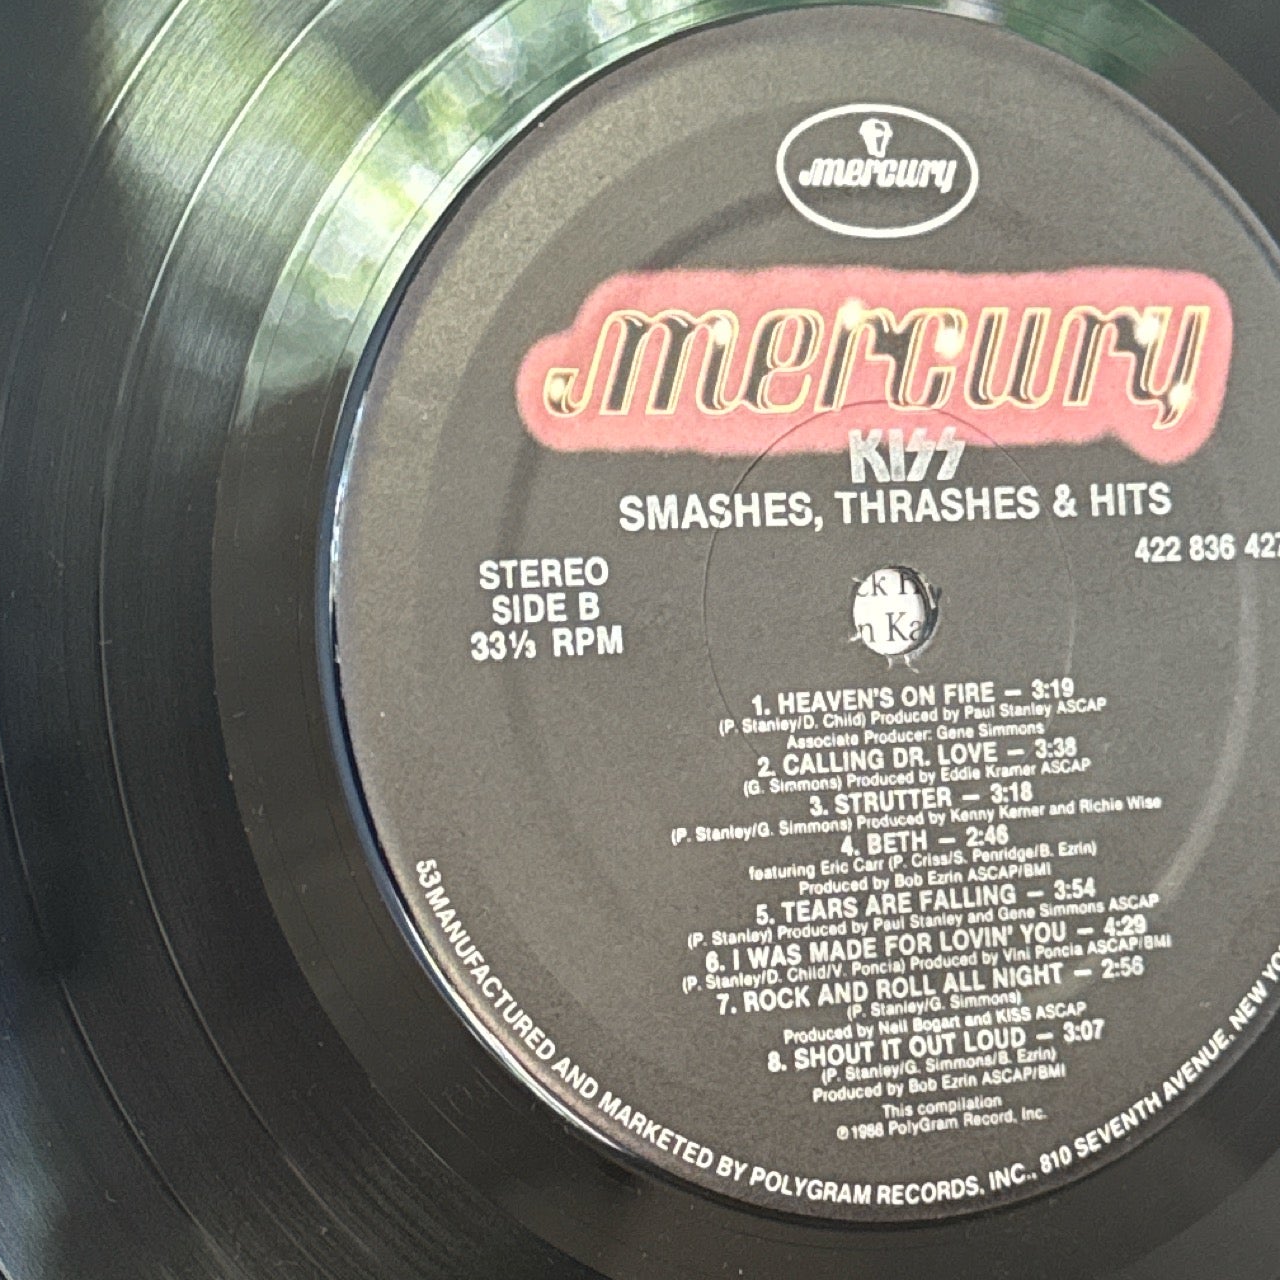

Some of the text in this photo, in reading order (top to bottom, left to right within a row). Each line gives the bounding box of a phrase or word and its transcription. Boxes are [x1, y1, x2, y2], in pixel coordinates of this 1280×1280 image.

[798, 158, 957, 194] mercury
[543, 304, 1210, 431] mercury
[848, 428, 966, 484] KISS
[619, 481, 1172, 532] SMASHES, THRASHES & HITS
[1135, 536, 1182, 563] 422
[1189, 533, 1236, 561] 836
[480, 556, 608, 589] STEREO
[492, 592, 600, 625] SIDE B
[552, 625, 624, 657] RPM
[752, 677, 1074, 716] 1. HEAVEN'S ON FIRE 3:19
[757, 736, 1077, 777] 2. CALLING DR. LOVE 3:38
[810, 781, 1033, 817] 3. STRUTTER 3:18
[841, 824, 1009, 856] 4. BETH 2:46
[756, 877, 1096, 926] 5. TEARS ARE FALLING 3:54
[706, 914, 1147, 975] 6. I WAS MADE FOR LOVIN' YOU 4:29
[716, 955, 1145, 1015] 7. ROCK AND ROLL ALL NIGHT 2:56
[425, 887, 556, 1061] MANUFACTURED
[552, 1057, 599, 1100] AND
[599, 1092, 714, 1170] MARKETED
[717, 1155, 745, 1182] BY
[750, 1167, 871, 1204] POLYGRAM
[876, 1176, 985, 1205] RECORDS,
[1040, 1148, 1072, 1173] 810
[1074, 1094, 1162, 1158] SEVENTH
[1164, 1029, 1235, 1101] AVENUE,
[1230, 982, 1269, 1032] NEW
[768, 1018, 1105, 1072] 8. SHOUT IT OUT LOUD 3:07
[881, 1095, 1003, 1119] This compilation
